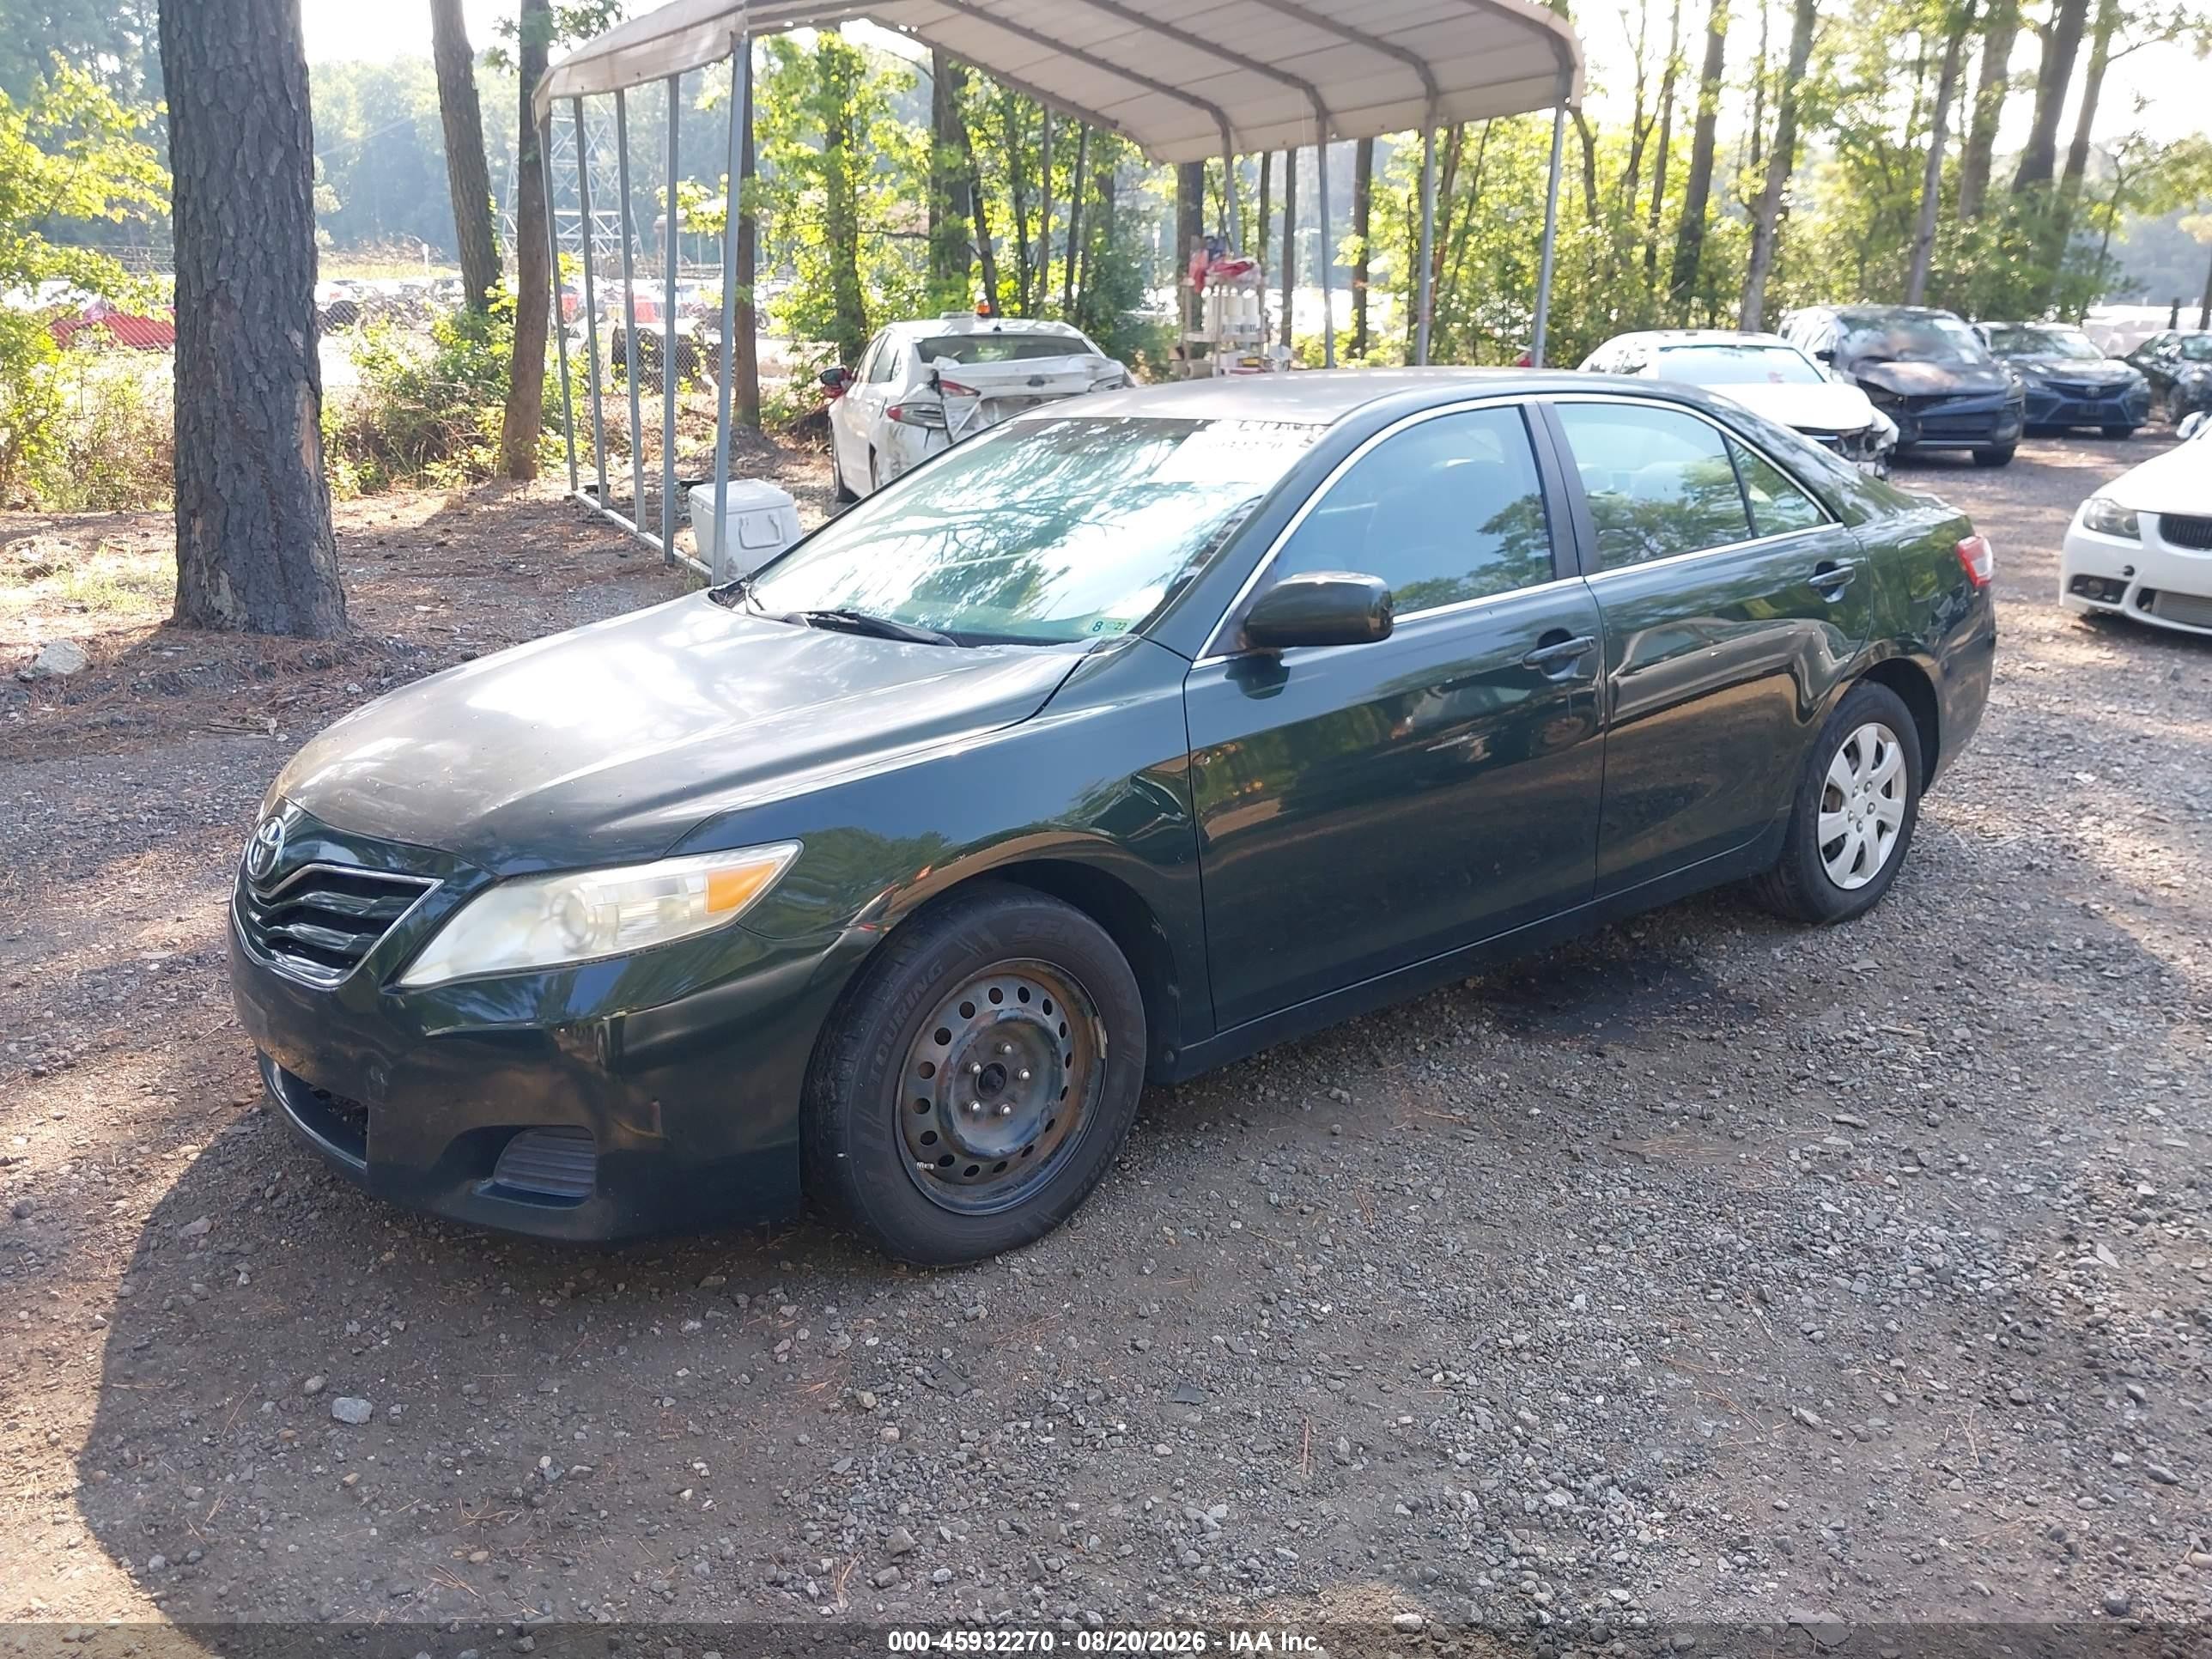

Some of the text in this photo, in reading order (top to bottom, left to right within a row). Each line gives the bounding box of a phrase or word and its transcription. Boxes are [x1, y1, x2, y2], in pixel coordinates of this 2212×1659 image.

[1092, 620, 1127, 632] 8 22
[869, 958, 944, 1080] TOURING
